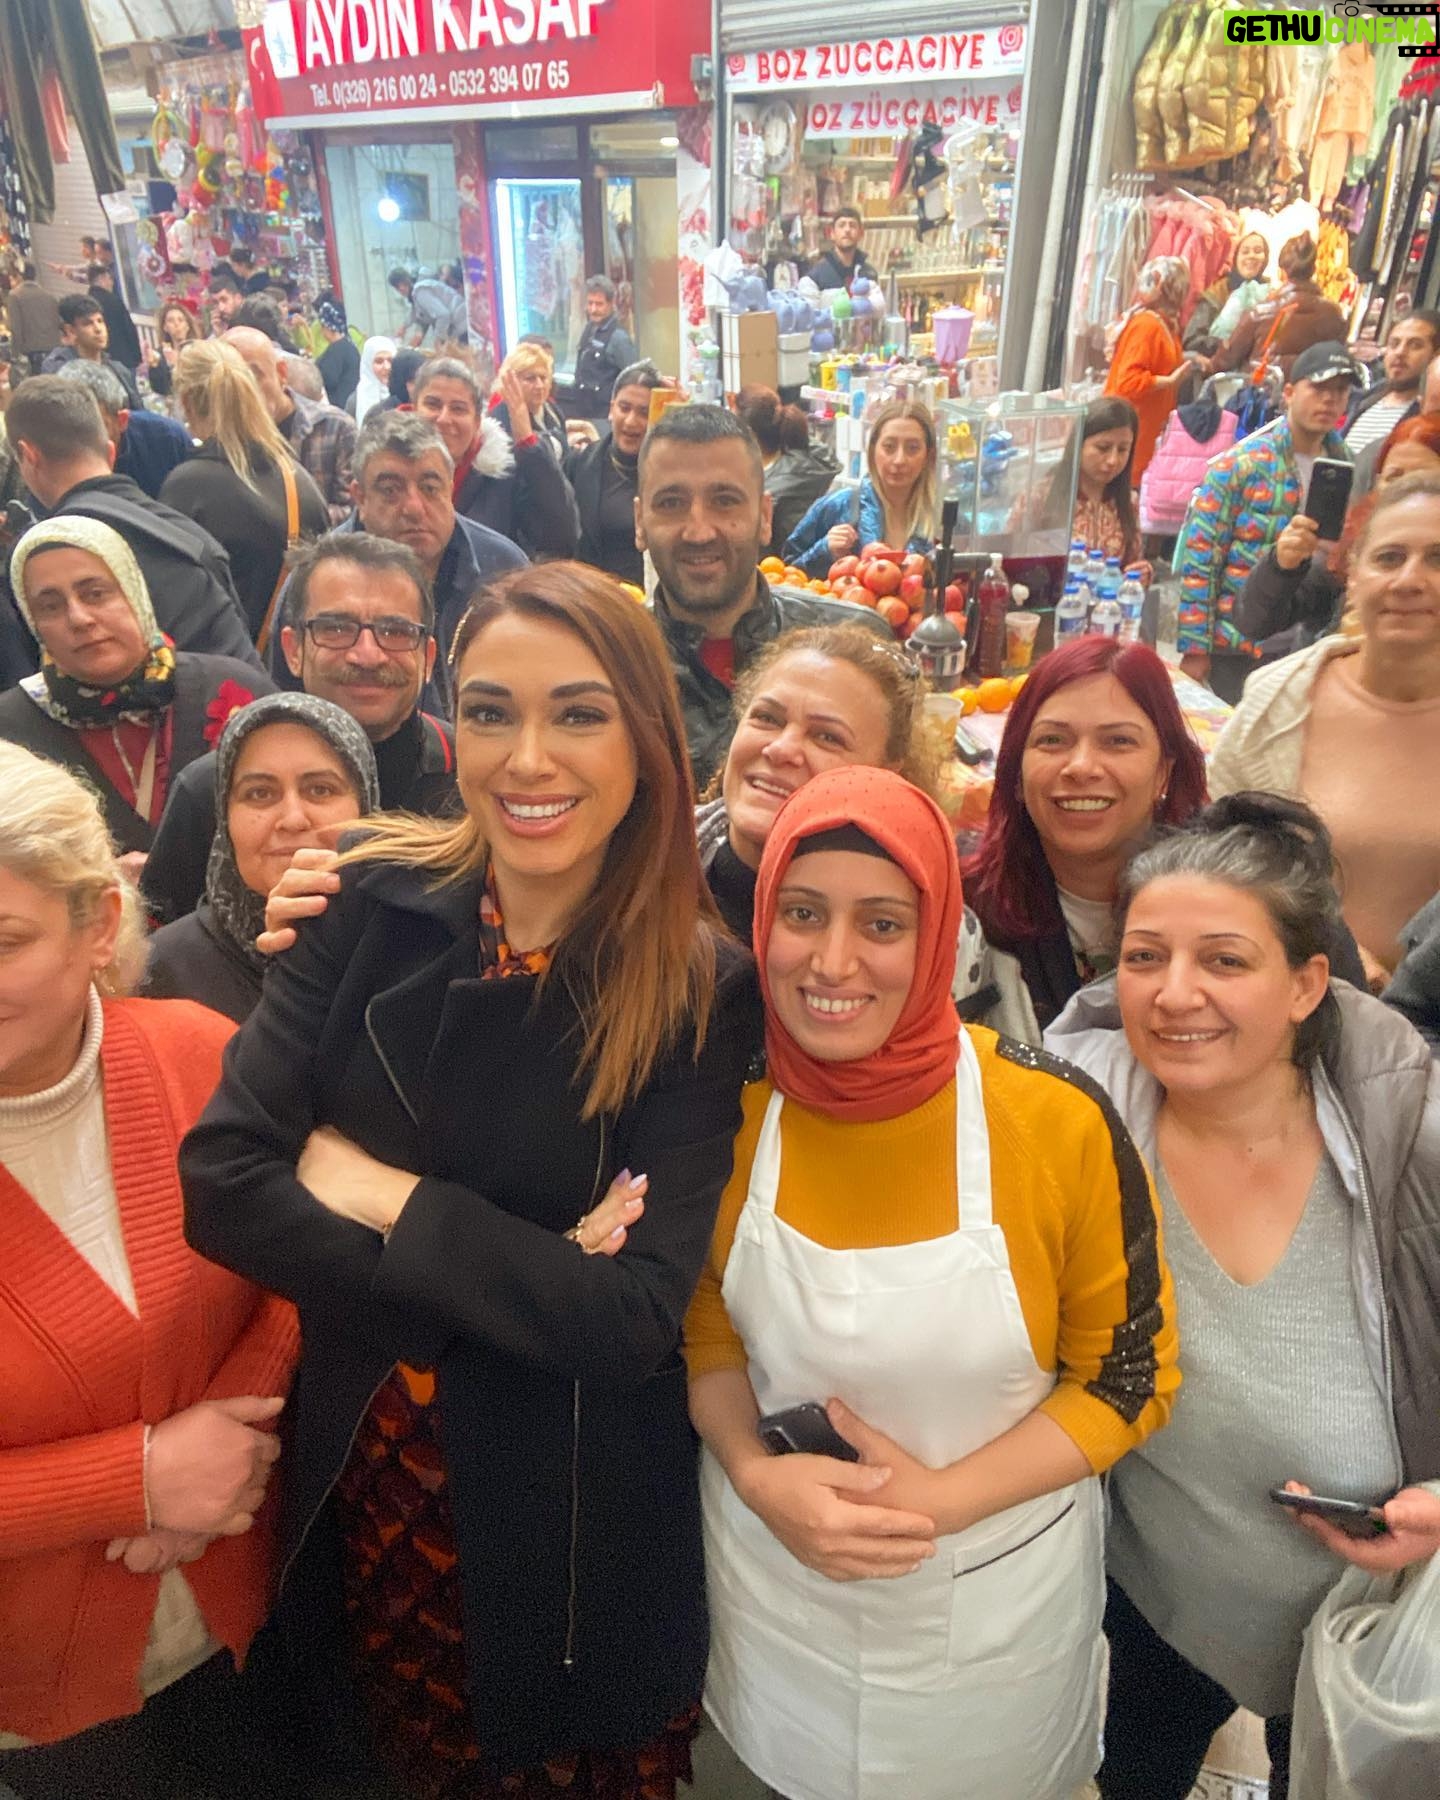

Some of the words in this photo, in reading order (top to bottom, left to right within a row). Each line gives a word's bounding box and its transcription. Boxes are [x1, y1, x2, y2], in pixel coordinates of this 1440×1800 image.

[306, 0, 419, 68] AYDIN
[310, 83, 332, 107] Tel.
[332, 78, 371, 109] 0(326)
[373, 76, 398, 102] 216
[399, 74, 417, 100] 00
[419, 72, 437, 98] 24
[449, 68, 485, 97] 0532
[489, 64, 519, 93] 394
[522, 62, 542, 92] 07
[547, 60, 570, 90] 65
[757, 47, 808, 83] BOZ
[804, 103, 842, 132] OZ
